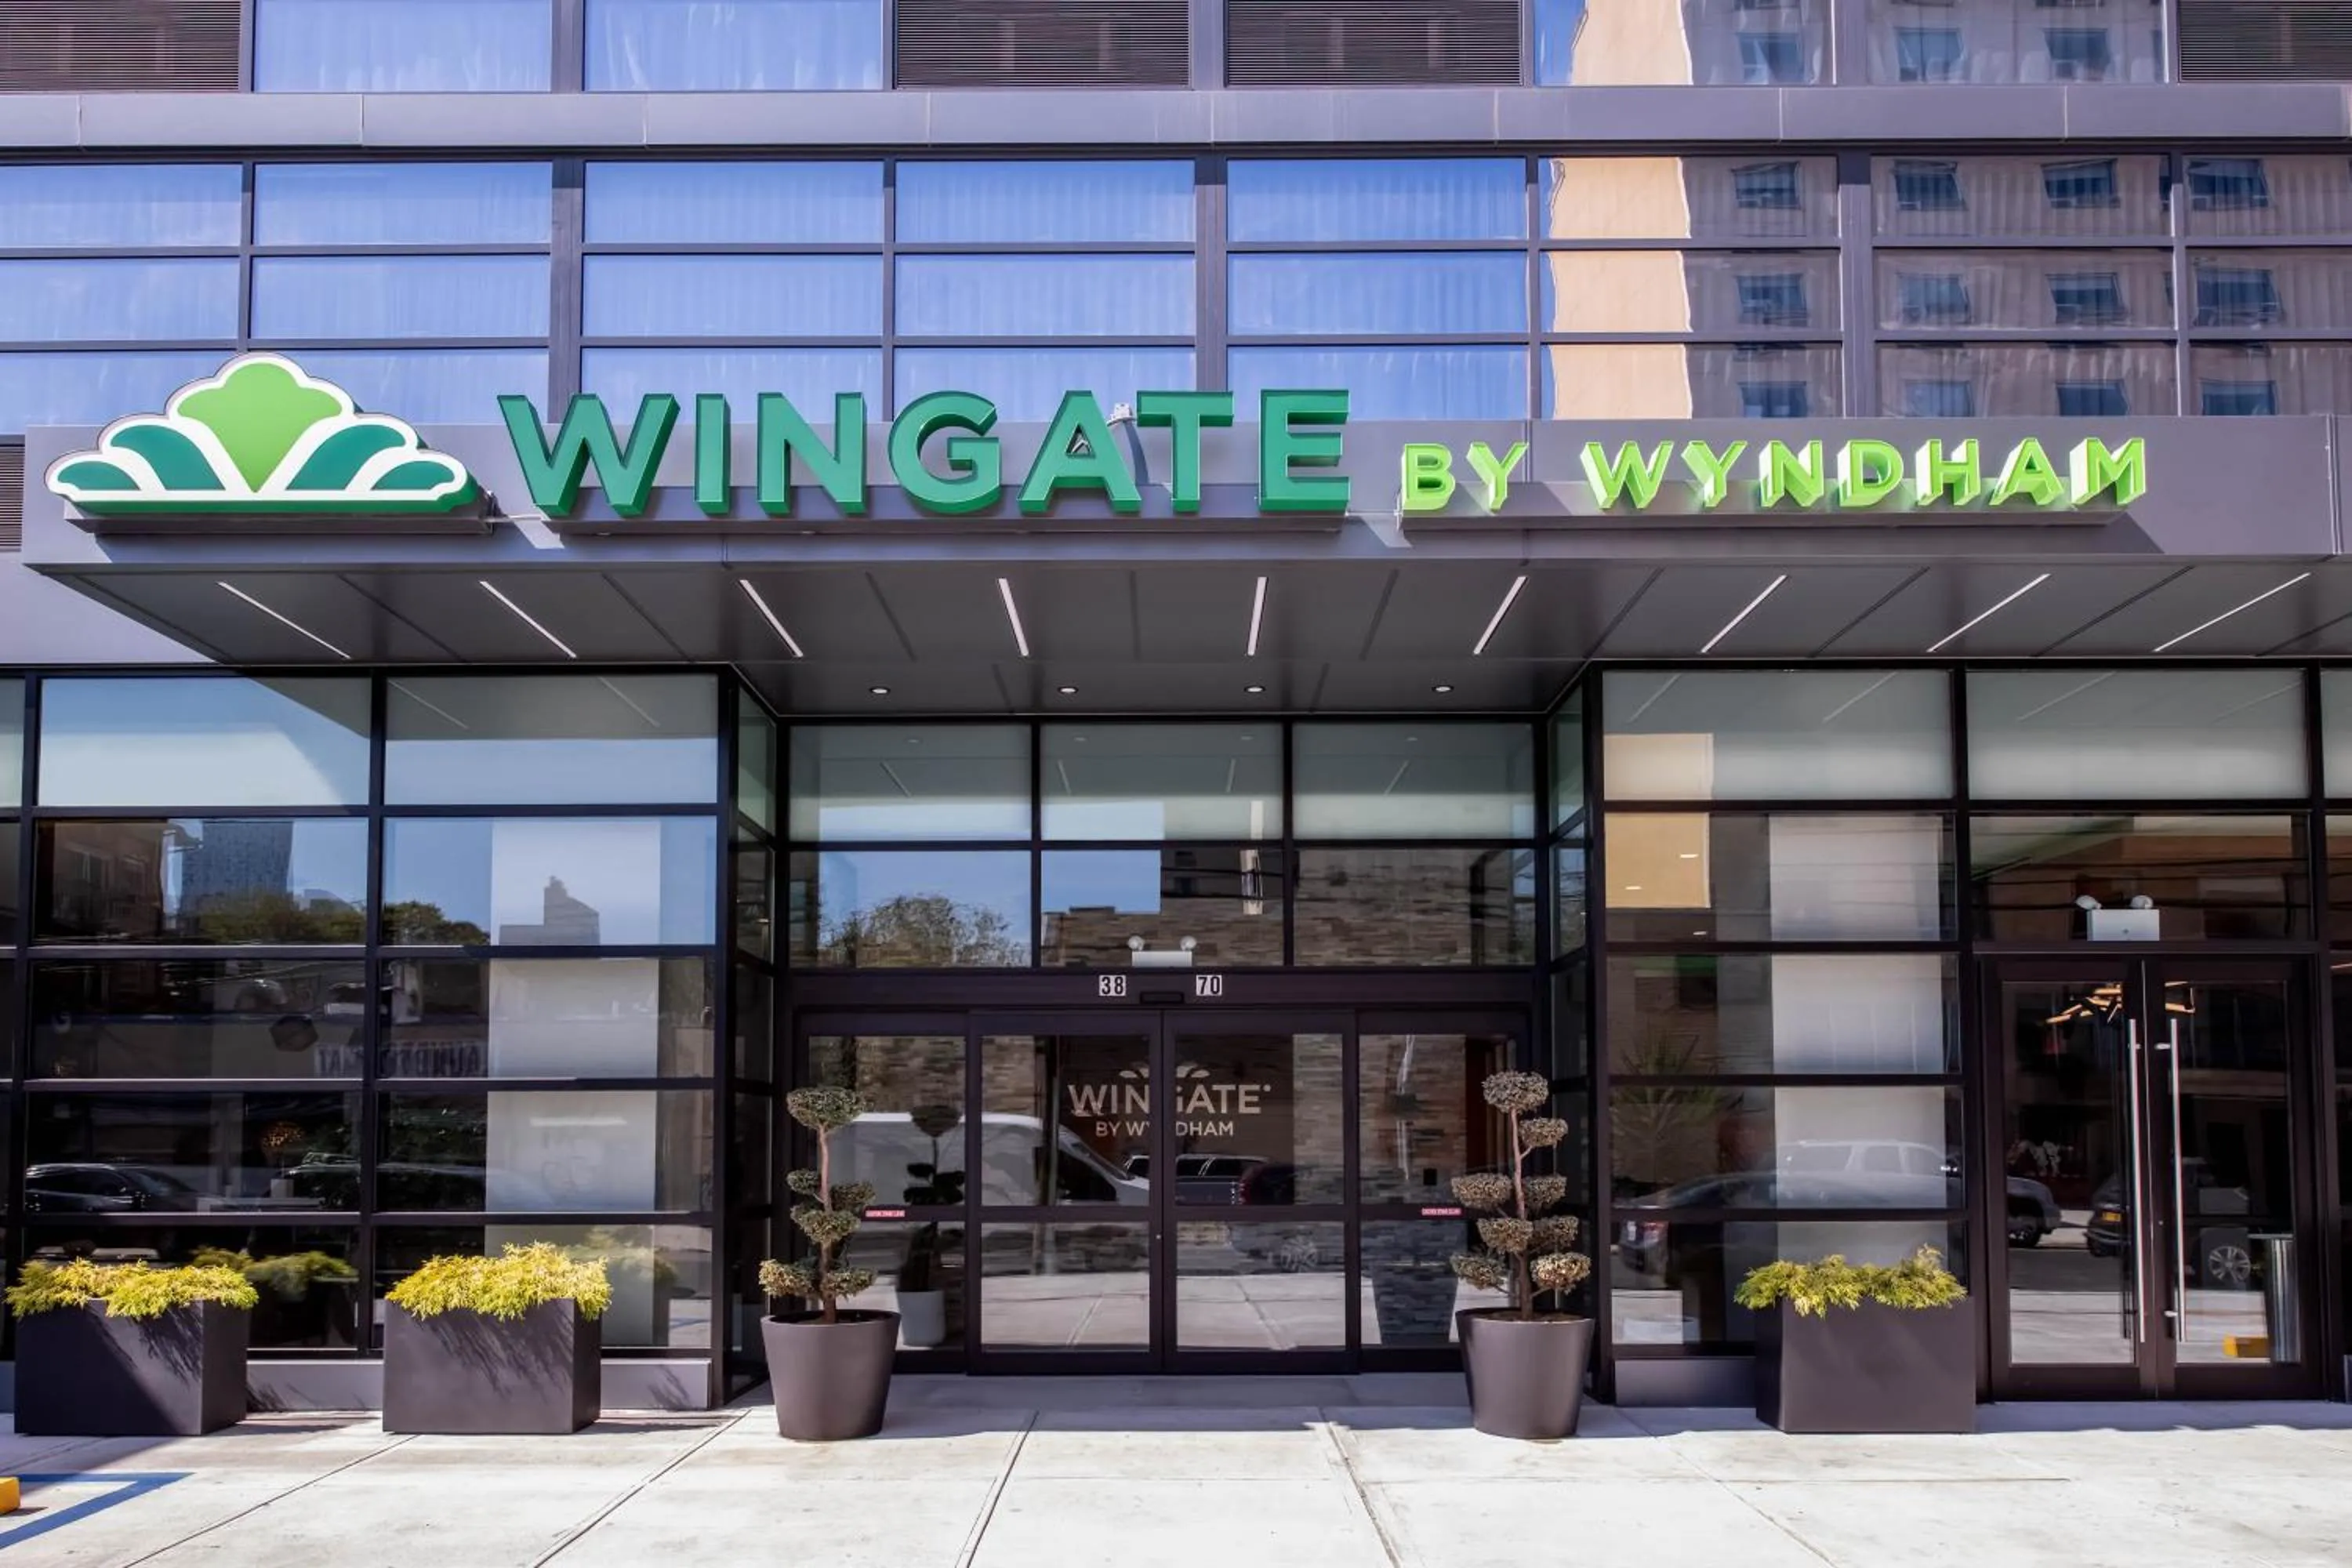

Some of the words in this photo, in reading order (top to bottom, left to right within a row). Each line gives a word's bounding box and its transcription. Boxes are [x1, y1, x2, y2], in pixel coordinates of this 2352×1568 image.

[497, 390, 1351, 516] WINGATE
[1400, 441, 1528, 513] BY
[1580, 437, 2147, 510] WYNDHAM
[1100, 976, 1125, 995] 38
[1196, 975, 1221, 995] 70
[1095, 1121, 1121, 1136] BY
[1126, 1121, 1233, 1136] WDHAM
